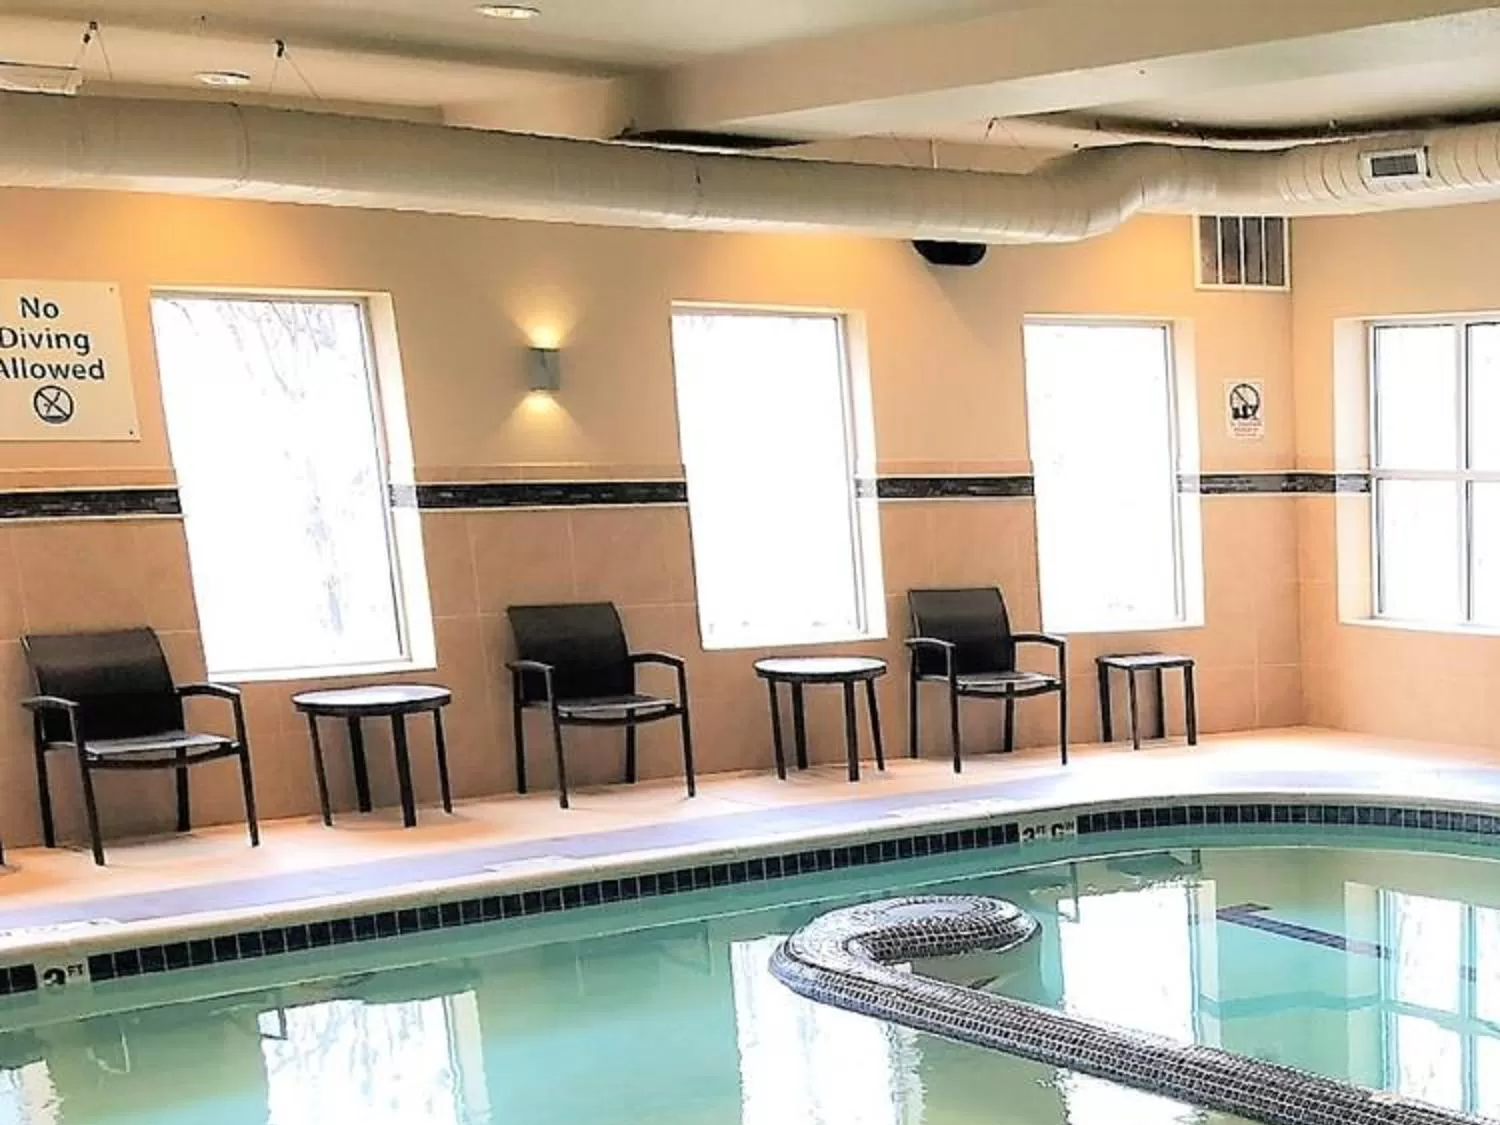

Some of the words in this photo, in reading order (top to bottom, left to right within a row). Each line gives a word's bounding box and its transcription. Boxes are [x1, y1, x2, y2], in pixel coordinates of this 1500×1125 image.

[20, 296, 59, 319] No
[0, 326, 91, 356] Diving
[67, 964, 83, 977] FT
